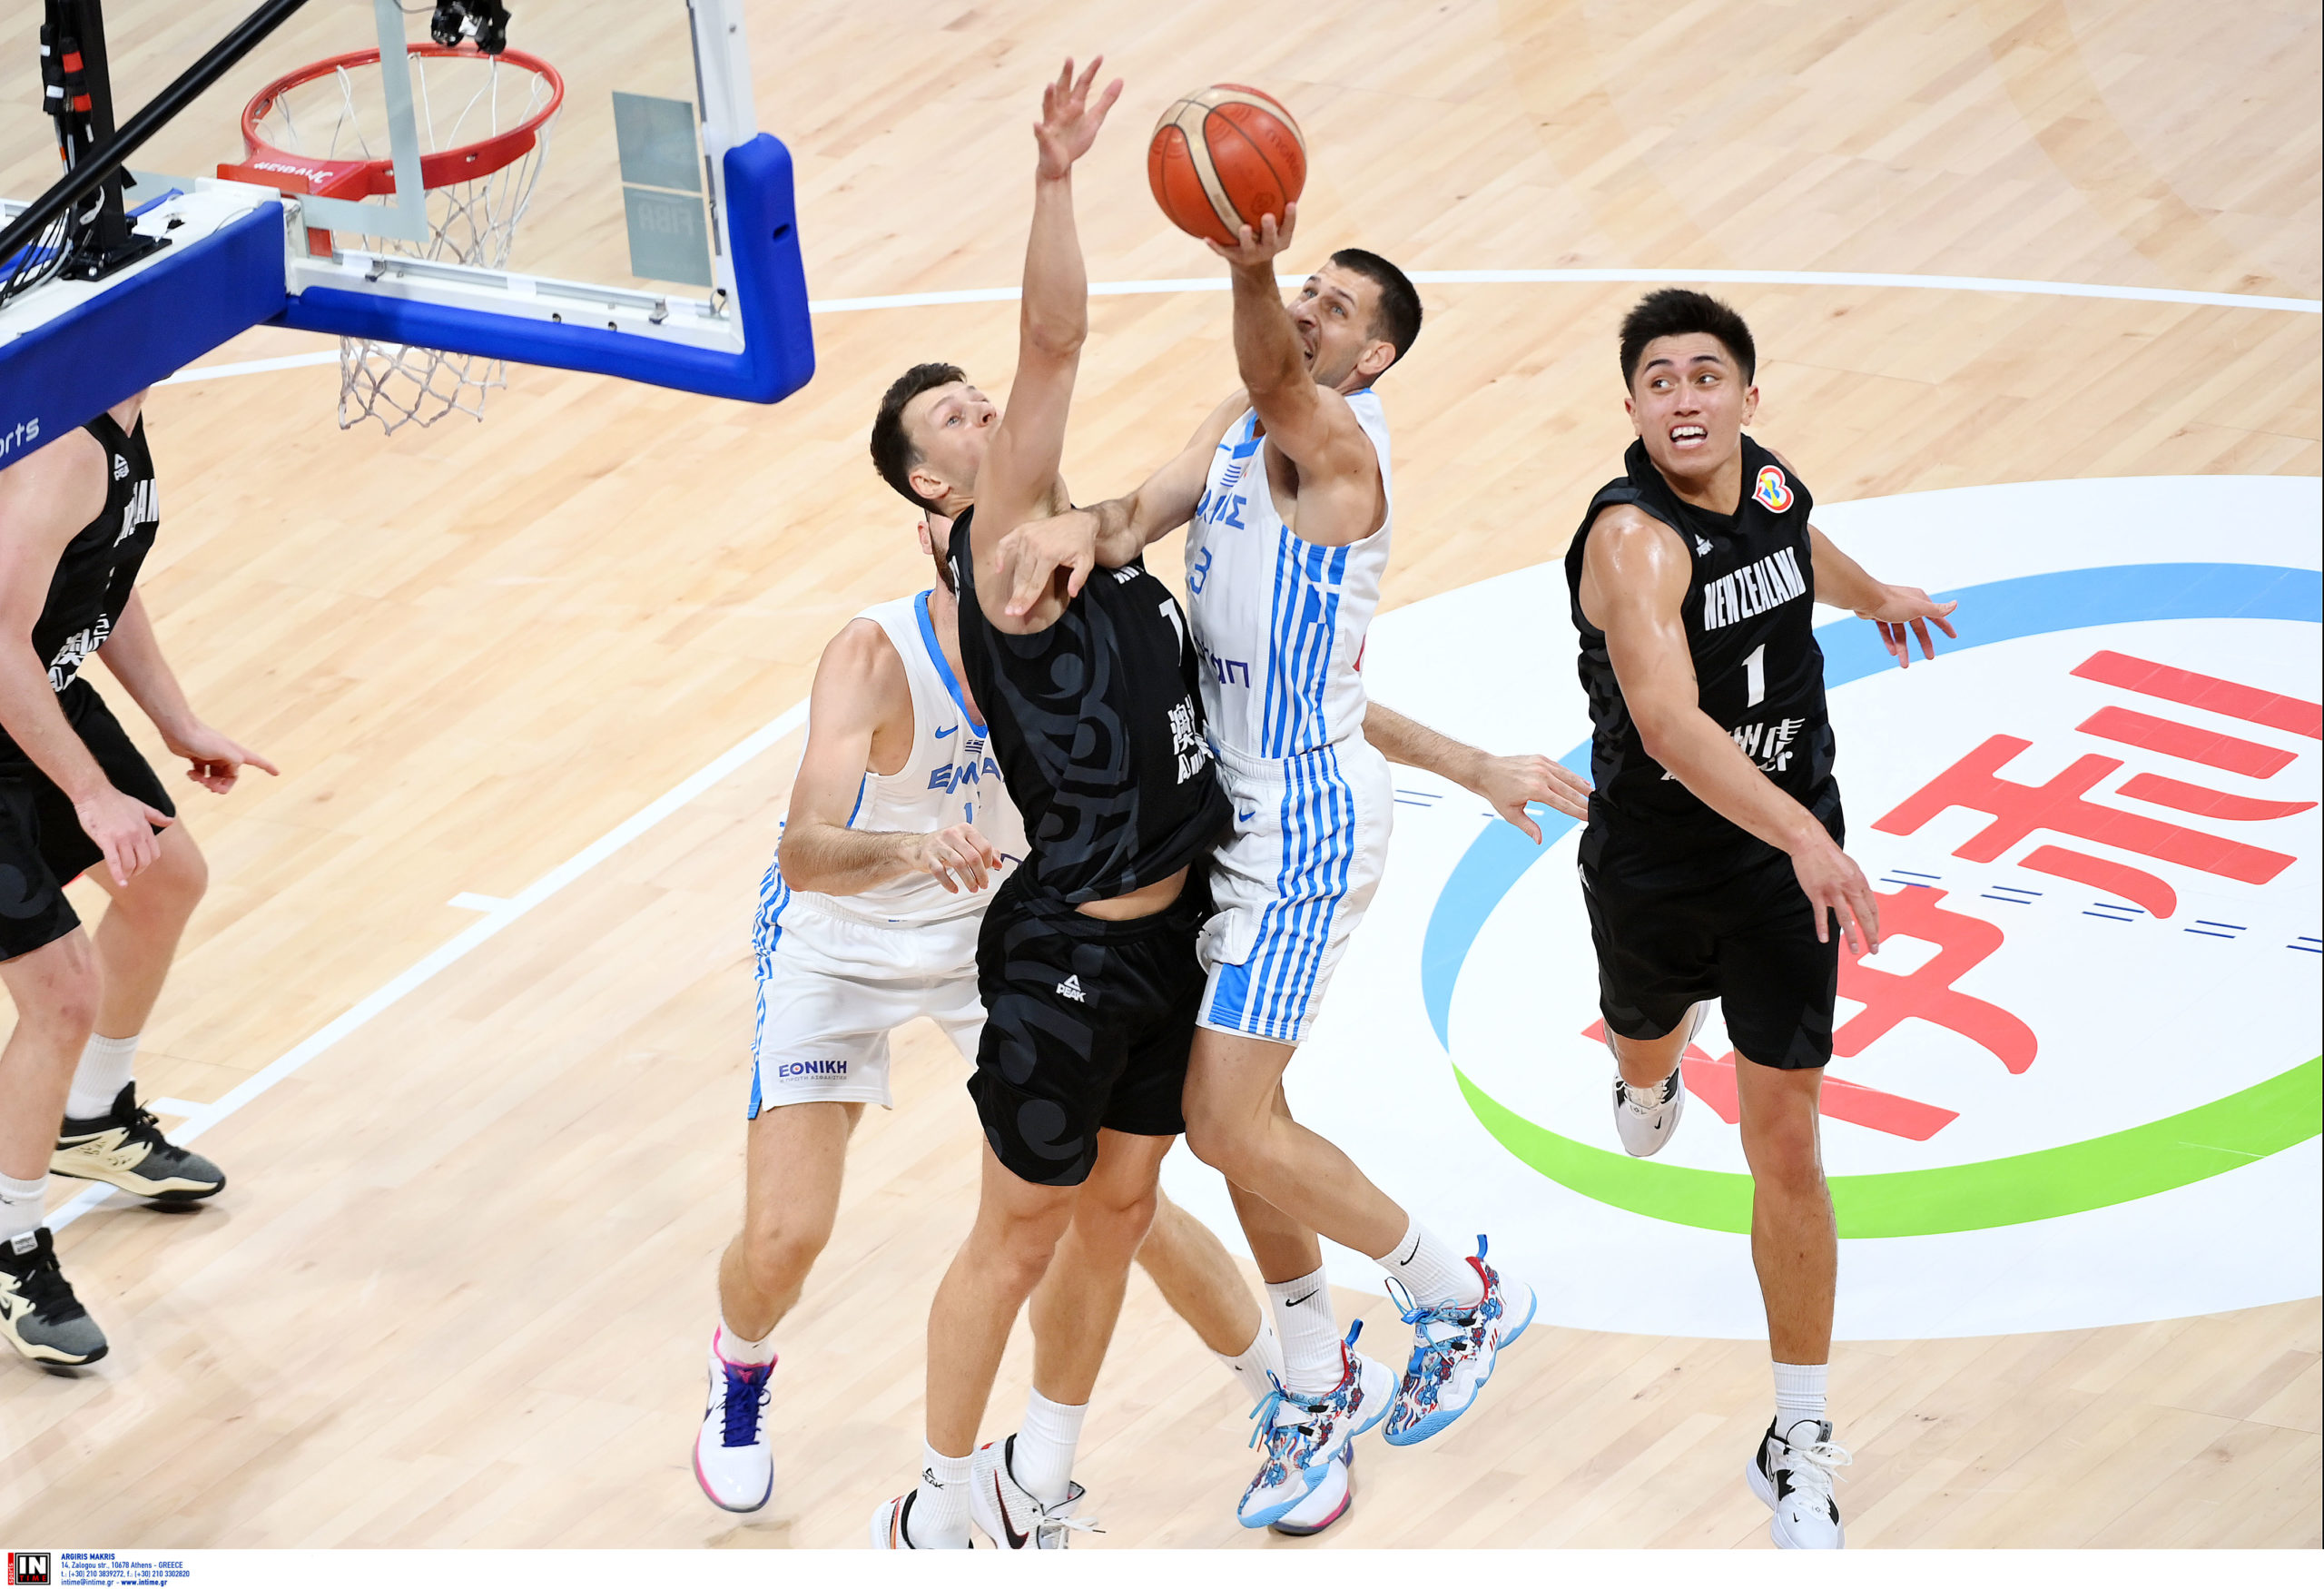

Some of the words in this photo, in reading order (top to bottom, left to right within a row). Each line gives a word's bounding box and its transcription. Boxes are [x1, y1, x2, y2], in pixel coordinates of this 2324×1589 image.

[1704, 573, 1740, 631] NEW
[1734, 546, 1807, 618] ZEALAND
[1741, 643, 1765, 707] 1
[928, 757, 1004, 794] ΕΛΛΑ
[1056, 982, 1087, 1003] PEAK
